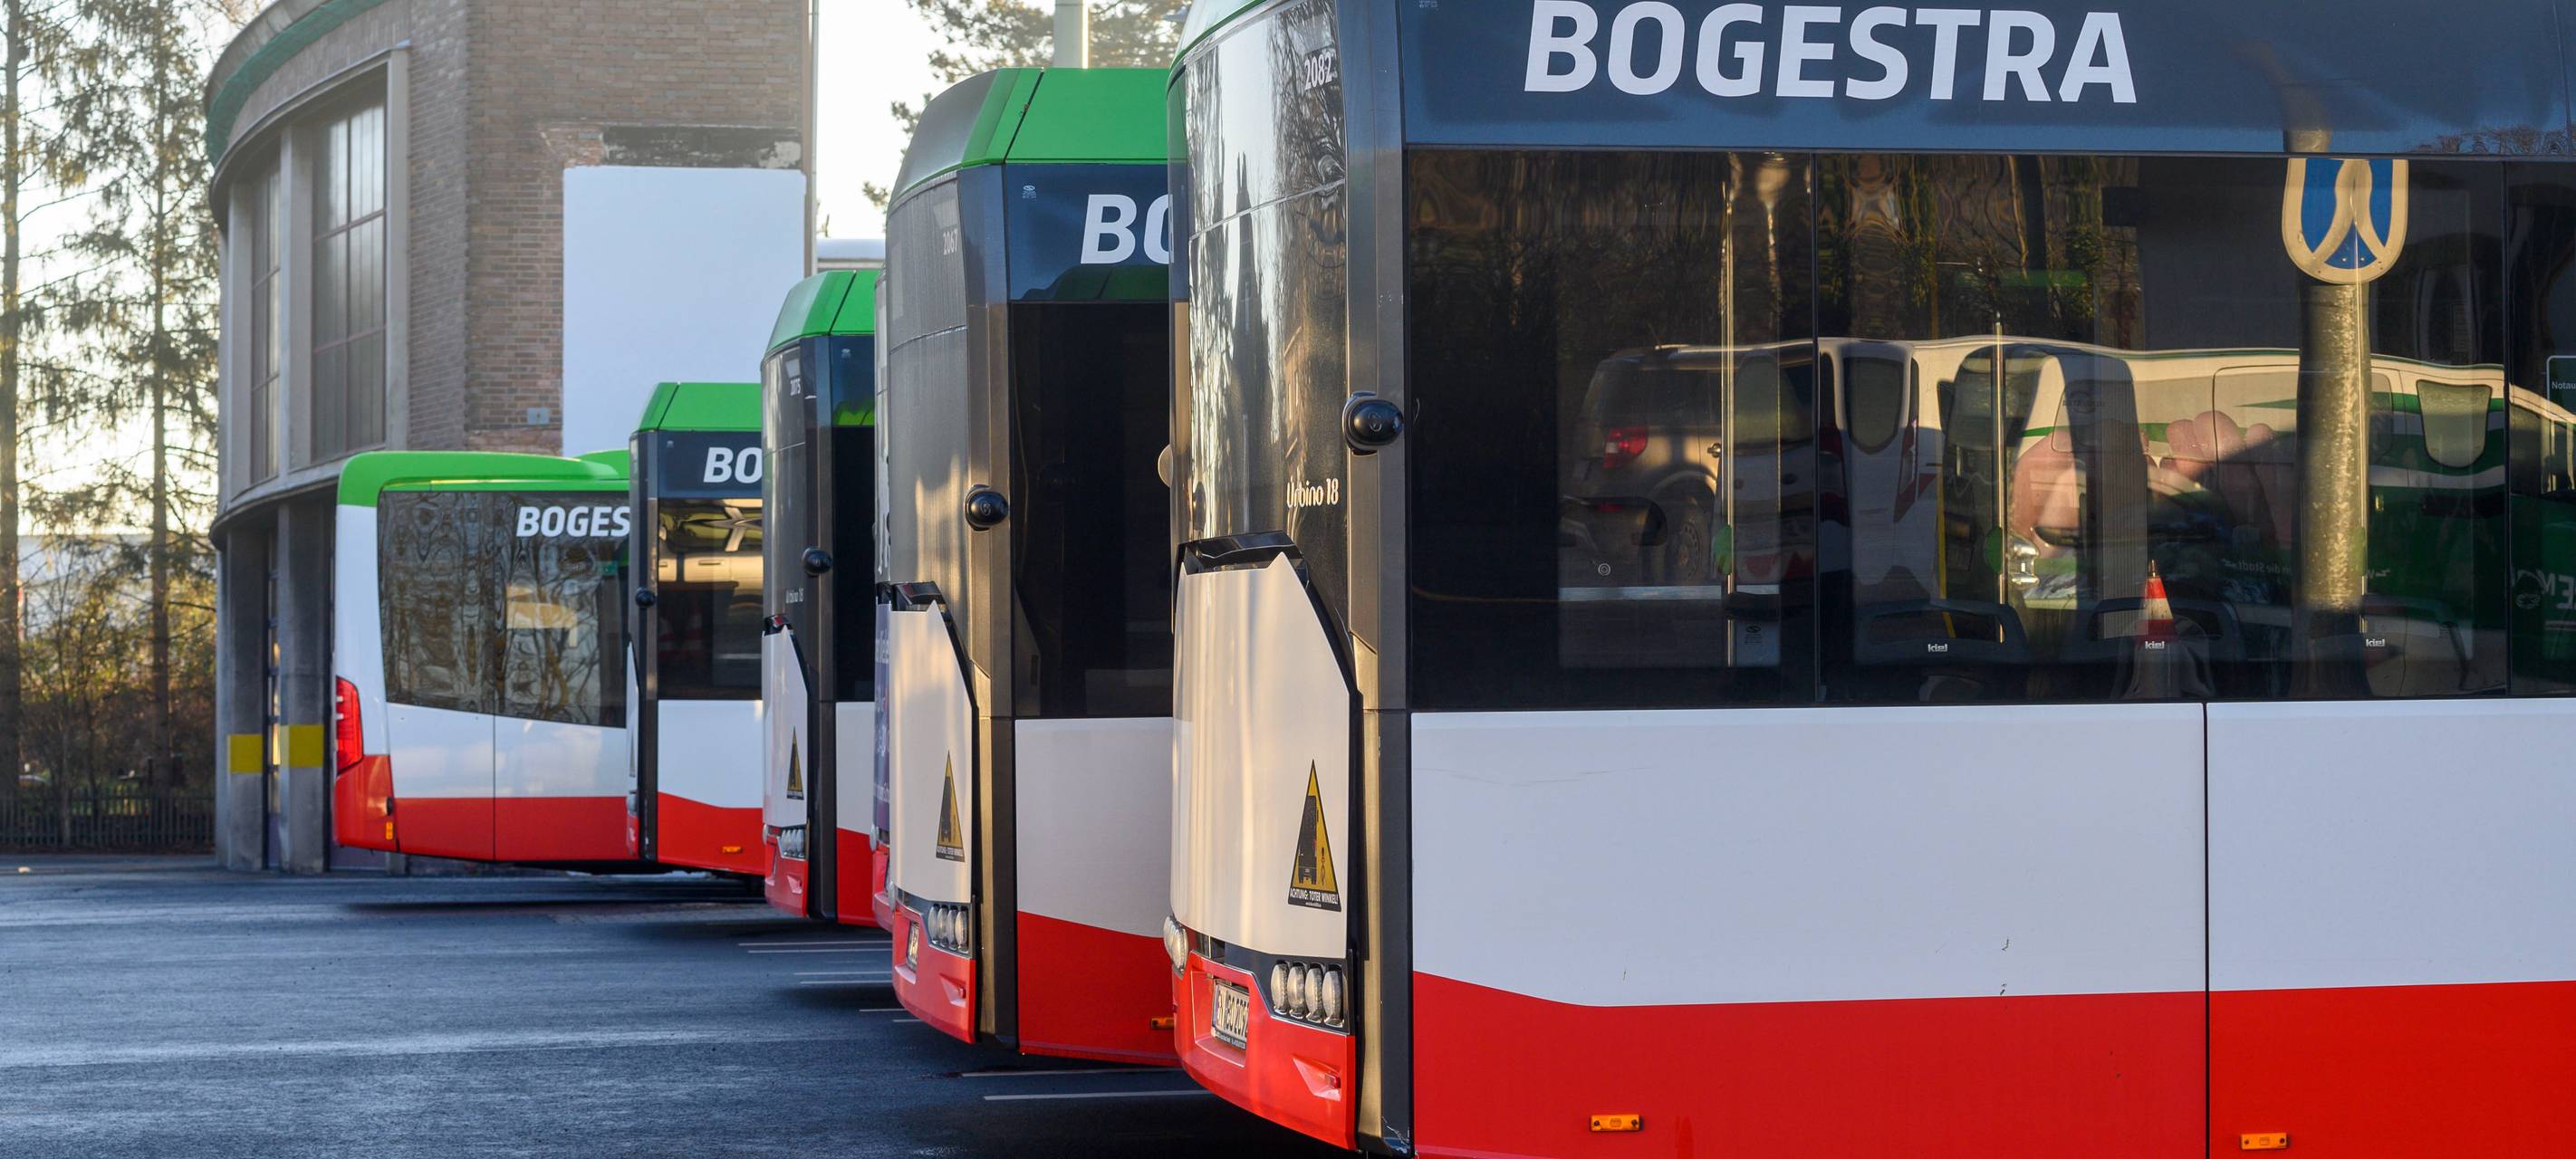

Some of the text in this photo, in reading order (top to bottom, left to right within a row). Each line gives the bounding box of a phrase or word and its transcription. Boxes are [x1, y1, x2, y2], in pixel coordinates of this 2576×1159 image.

[1524, 0, 2137, 104] BOGESTRA
[1304, 52, 1332, 91] 2082
[1287, 478, 1339, 508] Urbino 18
[515, 505, 630, 538] BOGES
[1927, 643, 1947, 652] kiel
[2145, 640, 2165, 649] kiel
[2366, 638, 2385, 647] kiel
